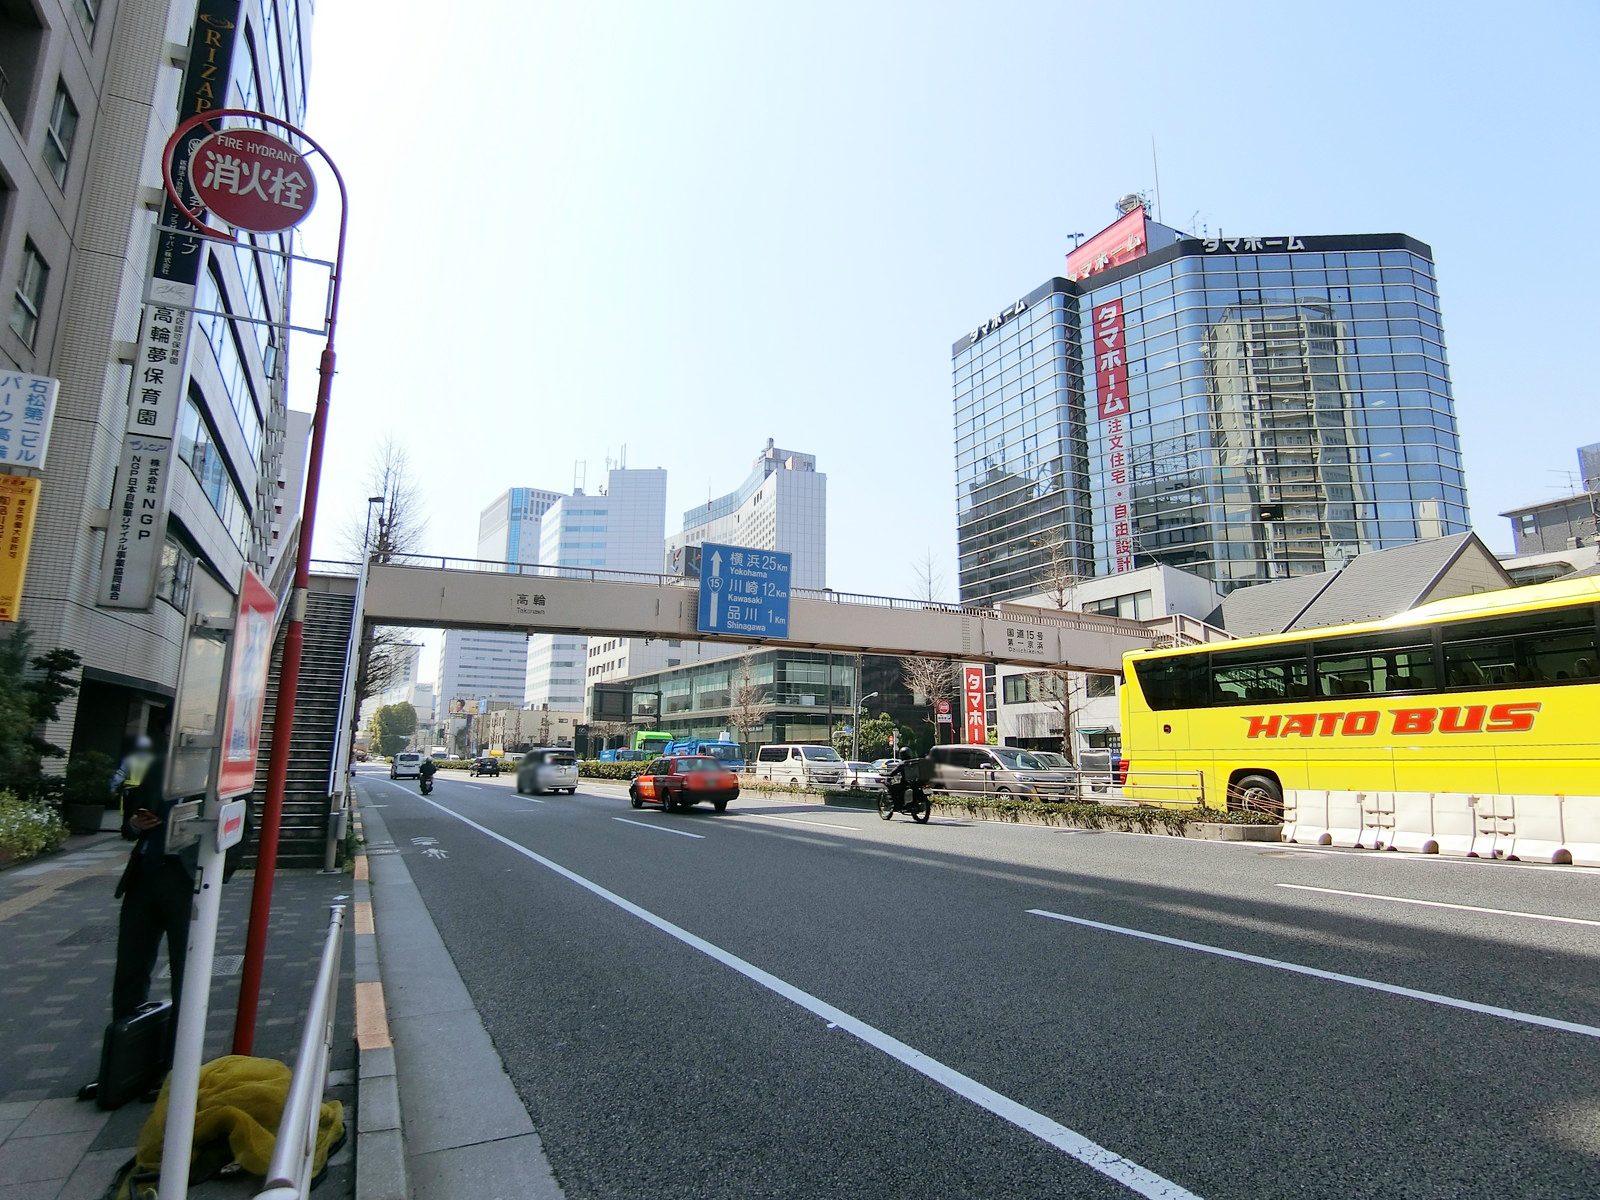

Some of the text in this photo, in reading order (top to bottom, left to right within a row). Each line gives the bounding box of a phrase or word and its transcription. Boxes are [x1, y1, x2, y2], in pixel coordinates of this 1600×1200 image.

[195, 28, 222, 114] RIZAP
[217, 135, 299, 164] FIRE HYDRANT
[202, 150, 308, 210] 消火栓
[1202, 235, 1305, 253] タマホーム
[969, 299, 1027, 343] タマホーム
[137, 305, 175, 426] 高輪夢保育園
[1098, 304, 1125, 415] タマホーム
[15, 378, 51, 462] 石松第二ビル
[146, 458, 161, 494] 株式会社
[1107, 418, 1132, 574] 注文住宅・自由設計
[138, 498, 156, 540] NGP
[729, 551, 760, 568] 横浜
[729, 567, 768, 579] Yokohama
[516, 593, 546, 606] 高輪
[710, 578, 720, 589] 15
[727, 593, 763, 605] Kawasaki
[728, 578, 758, 595] 川崎
[726, 620, 766, 632] Shinagawa
[727, 605, 758, 622] 品川
[1006, 627, 1044, 641] 国道15号
[967, 673, 984, 746] タマホー
[1240, 702, 1542, 739] HATO BUS
